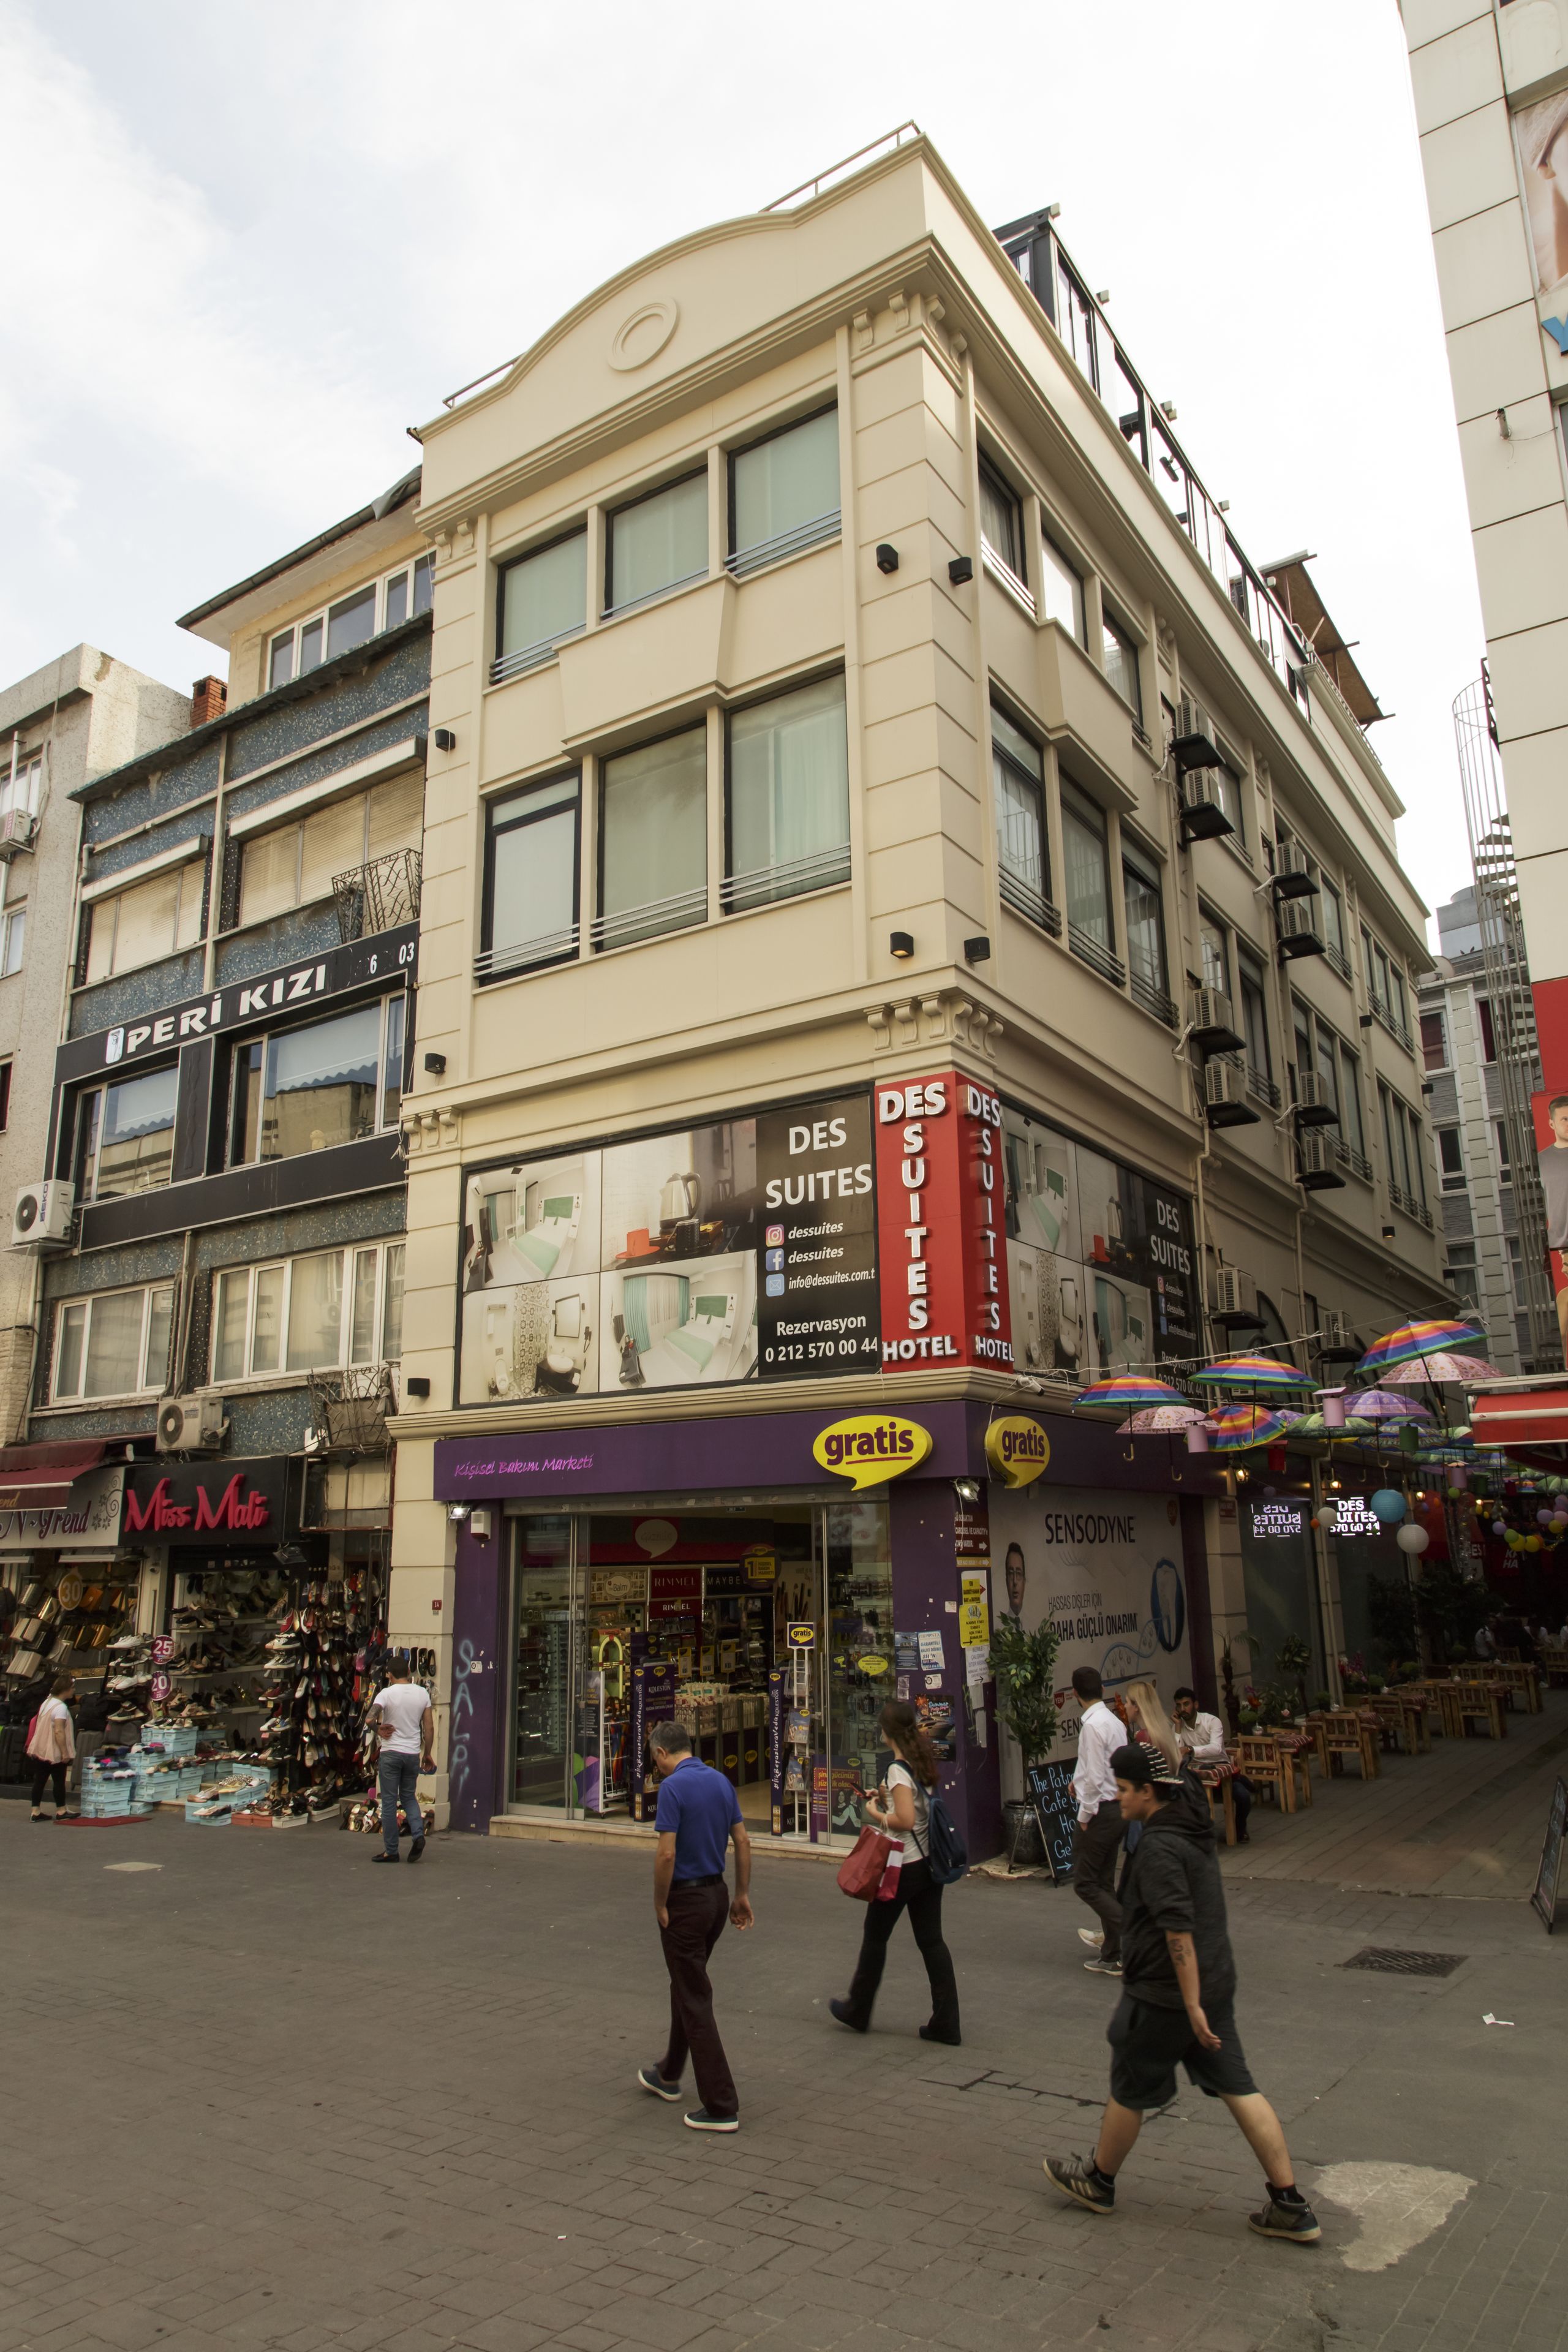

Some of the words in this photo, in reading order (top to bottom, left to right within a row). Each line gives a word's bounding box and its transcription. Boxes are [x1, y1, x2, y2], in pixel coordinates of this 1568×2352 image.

[399, 942, 415, 965] 03
[127, 993, 221, 1054] PERİ
[239, 965, 326, 1016] KIZI
[879, 1082, 946, 1123] DES
[968, 1084, 1001, 1127] DES
[790, 1117, 846, 1155] DES
[766, 1164, 872, 1208] SUITES
[40, 1183, 48, 1222] BEKO
[1156, 1199, 1180, 1233] DES
[788, 1222, 843, 1239] dessuites
[788, 1247, 844, 1264] dessuites
[1152, 1235, 1191, 1275] SUITES
[1165, 1282, 1183, 1297] dessuites
[1167, 1302, 1185, 1317] dessuites
[777, 1315, 867, 1336] Rezervasyon
[765, 1348, 774, 1362] 0
[778, 1344, 804, 1361] 212
[809, 1341, 834, 1358] 570
[839, 1339, 857, 1355] 00
[861, 1336, 878, 1352] 44
[882, 1335, 959, 1362] HOTEL
[975, 1335, 1015, 1362] HOTEL
[1176, 1378, 1186, 1393] 570
[824, 1422, 914, 1466] gratis
[1001, 1425, 1046, 1462] gratis
[454, 1460, 496, 1480] Kişisel
[498, 1459, 539, 1474] Bakım
[541, 1453, 594, 1471] Marketi
[125, 1478, 192, 1532] Miss
[1336, 1512, 1378, 1523] UITES
[1338, 1500, 1364, 1511] DES
[1045, 1513, 1136, 1544] SENSODYNE
[62, 1581, 80, 1602] 30
[655, 1576, 696, 1586] RIMMEL
[1048, 1594, 1071, 1611] HASSAS
[1072, 1593, 1090, 1611] DİŞLER
[1077, 1611, 1103, 1643] GÜÇLÜ
[1106, 1613, 1138, 1636] ONARIM
[153, 1640, 173, 1655] 25
[151, 1675, 167, 1692] 20
[1030, 1770, 1049, 1793] The
